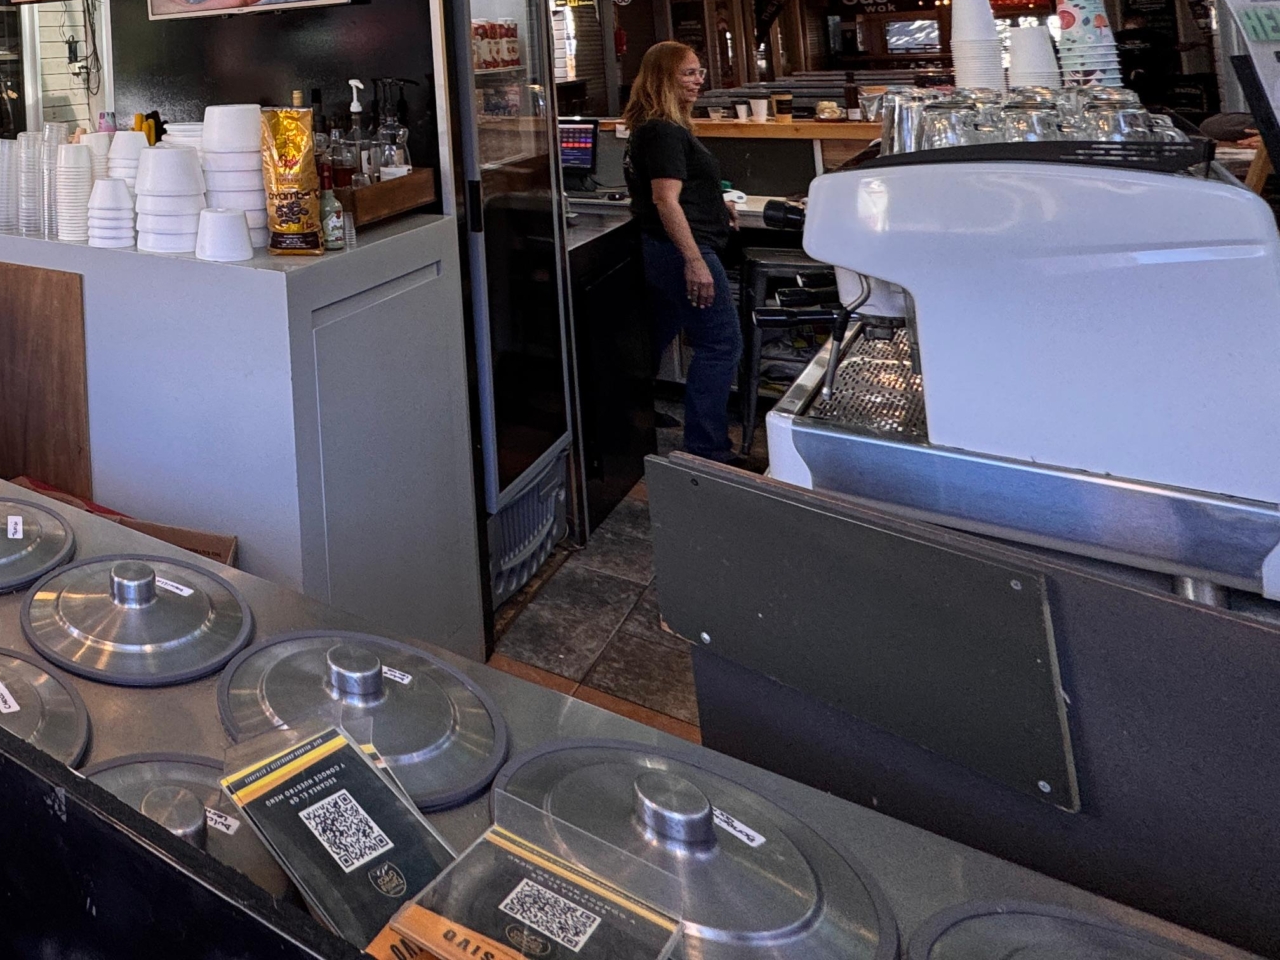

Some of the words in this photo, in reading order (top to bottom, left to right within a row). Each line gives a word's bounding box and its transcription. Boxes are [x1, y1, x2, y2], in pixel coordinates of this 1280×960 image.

[864, 3, 897, 13] wok
[283, 777, 313, 797] NUESTRO
[288, 795, 300, 805] QR
[298, 791, 308, 800] EL
